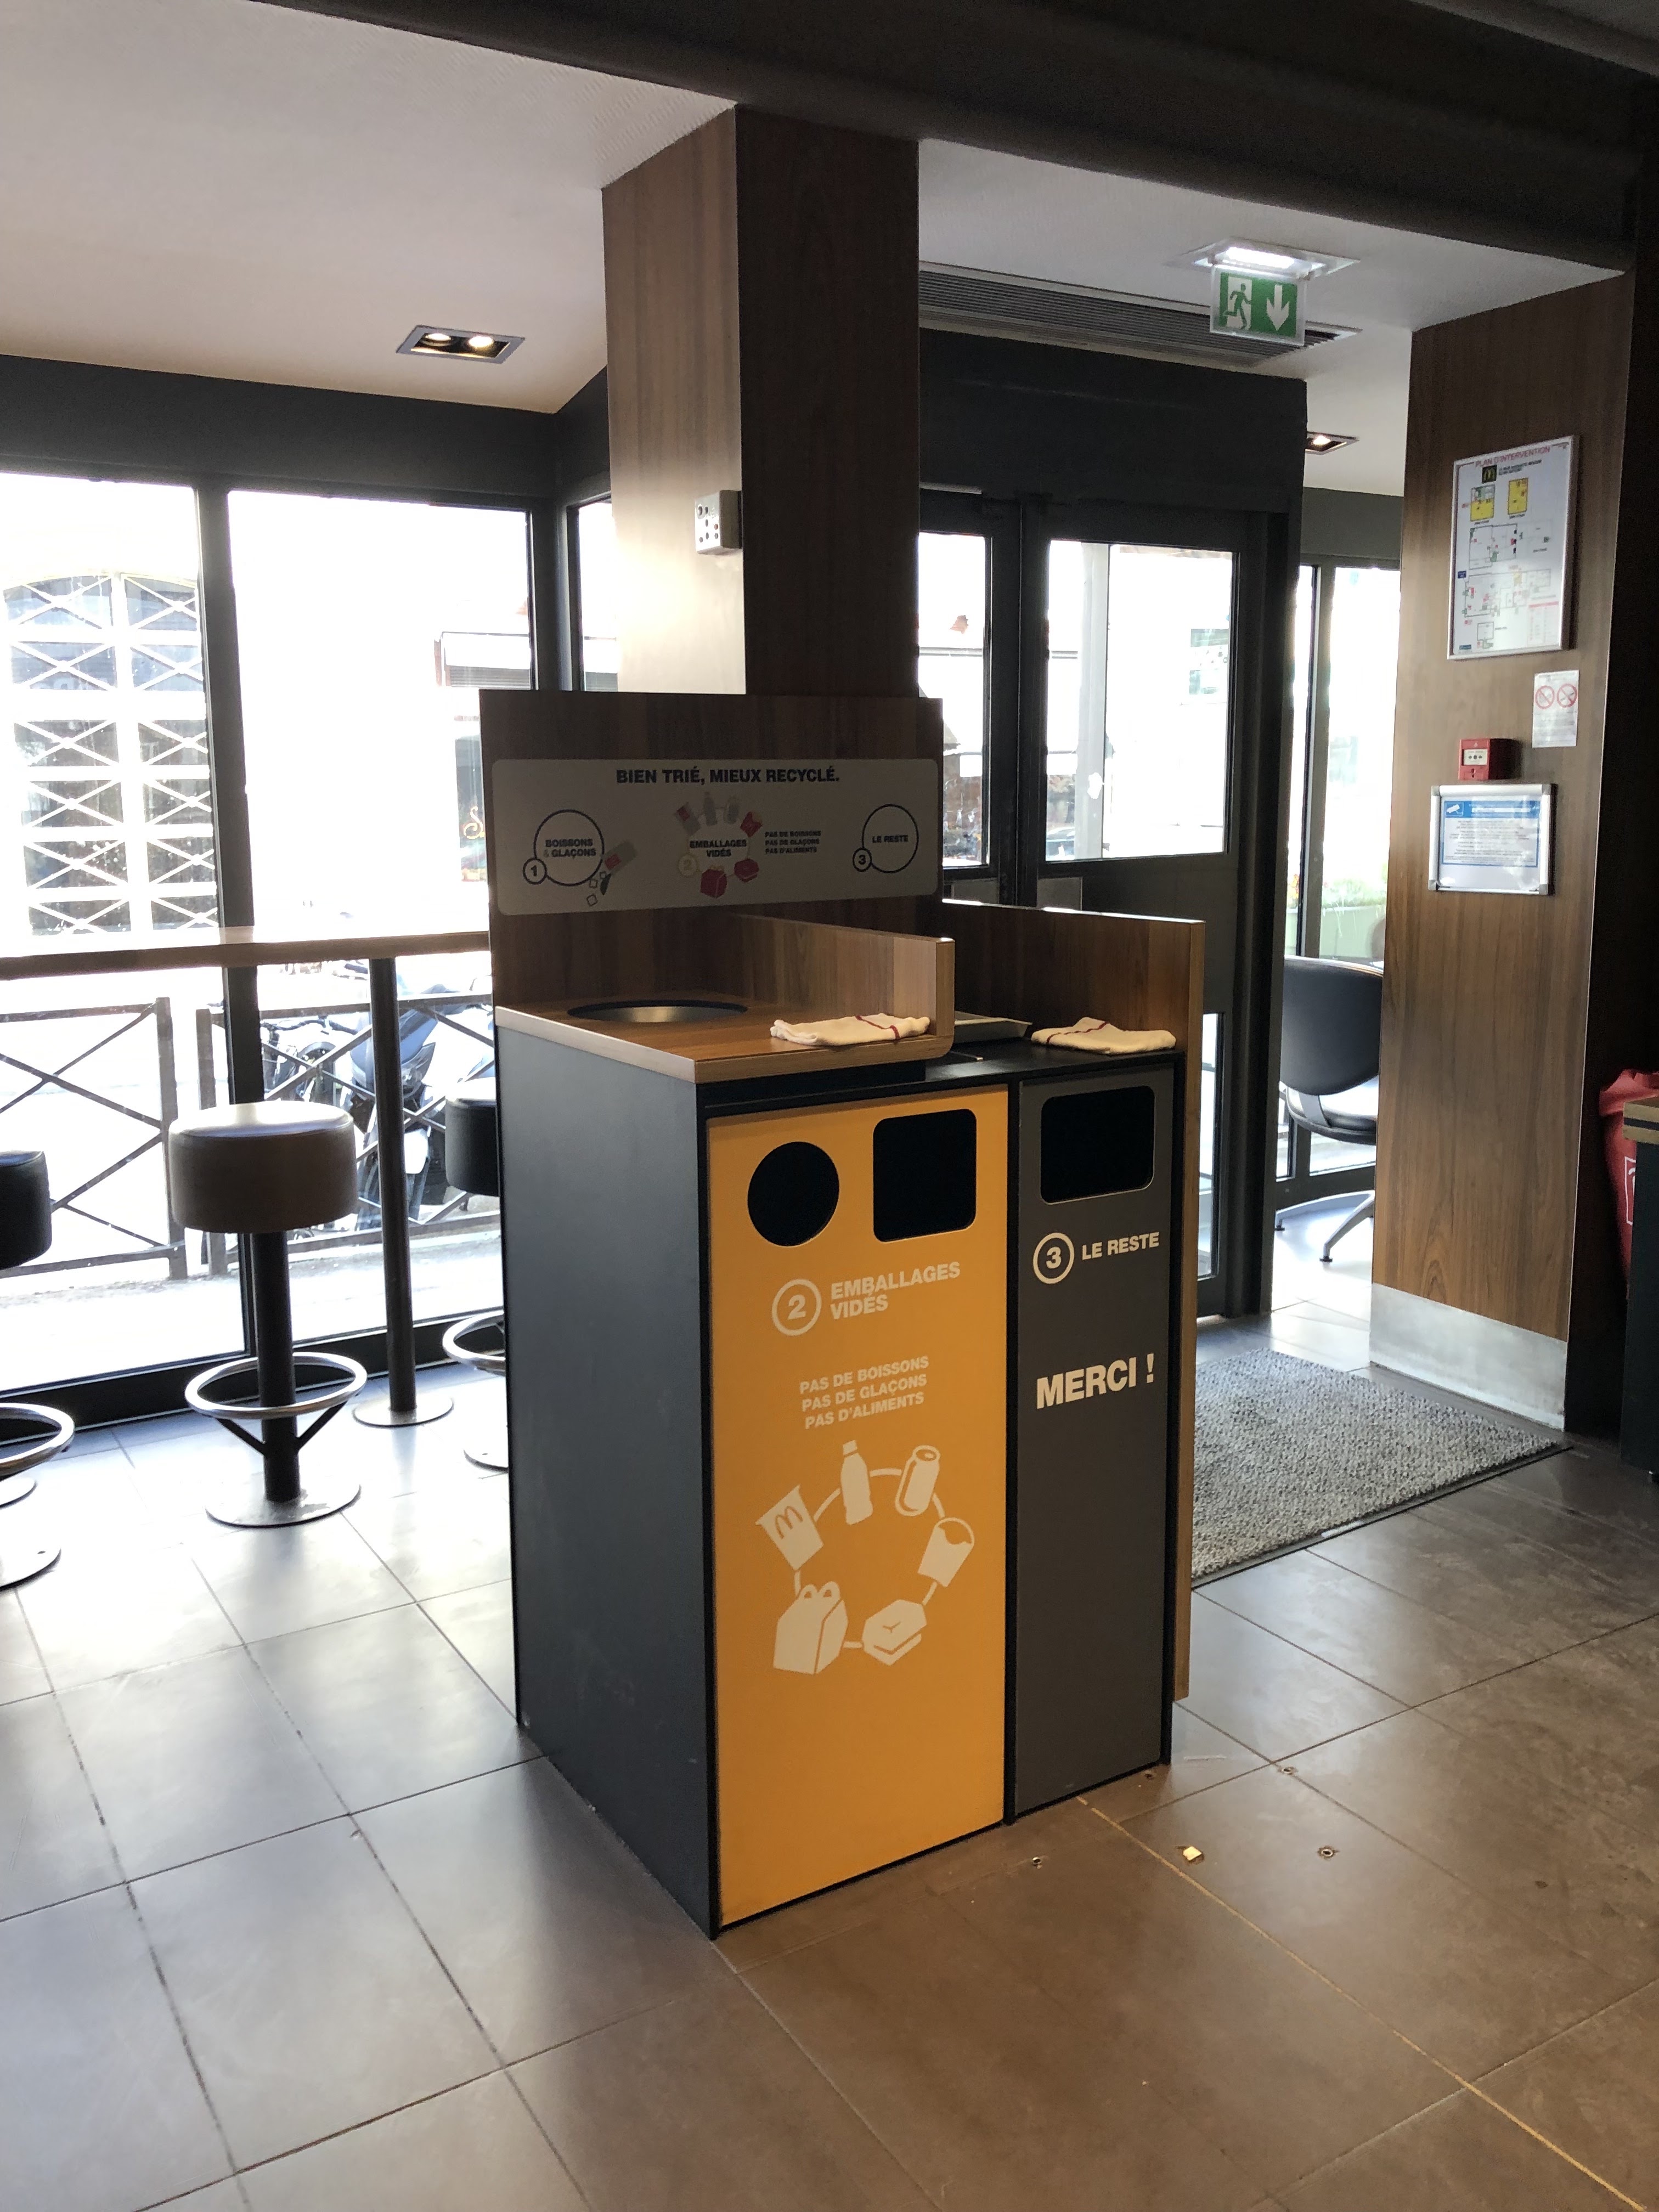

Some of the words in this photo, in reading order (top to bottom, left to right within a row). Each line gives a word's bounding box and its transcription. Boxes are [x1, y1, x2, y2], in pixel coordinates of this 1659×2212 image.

[1475, 459, 1492, 467] PLAN
[616, 769, 657, 783] BIEN
[662, 765, 705, 785] TRIÉ,
[709, 769, 761, 783] MIEUX
[766, 765, 839, 782] RECYCLÉ.
[545, 839, 593, 848] BOISSONS
[689, 839, 747, 848] EMBALLAGES
[884, 834, 909, 843] RESTE
[552, 848, 596, 859] GLAÇONS
[706, 848, 731, 857] VIDÉS
[858, 854, 866, 865] 3
[531, 865, 538, 877] 1
[1046, 1246, 1062, 1269] 3
[1082, 1242, 1103, 1261] LE
[1107, 1232, 1160, 1256] RESTE
[830, 1261, 961, 1300] EMBALLAGES
[787, 1294, 806, 1321] 2
[830, 1291, 889, 1320] VIDÉS
[799, 1376, 830, 1395] PAS
[833, 1372, 854, 1387] DE
[857, 1356, 929, 1383] BOISSONS
[1036, 1356, 1137, 1409] MERCI
[802, 1394, 831, 1412] PAS
[835, 1389, 856, 1404] DE
[859, 1373, 927, 1399] GLAÇONS
[805, 1411, 834, 1430] PAS
[838, 1391, 924, 1422] D'ALIMENTS
